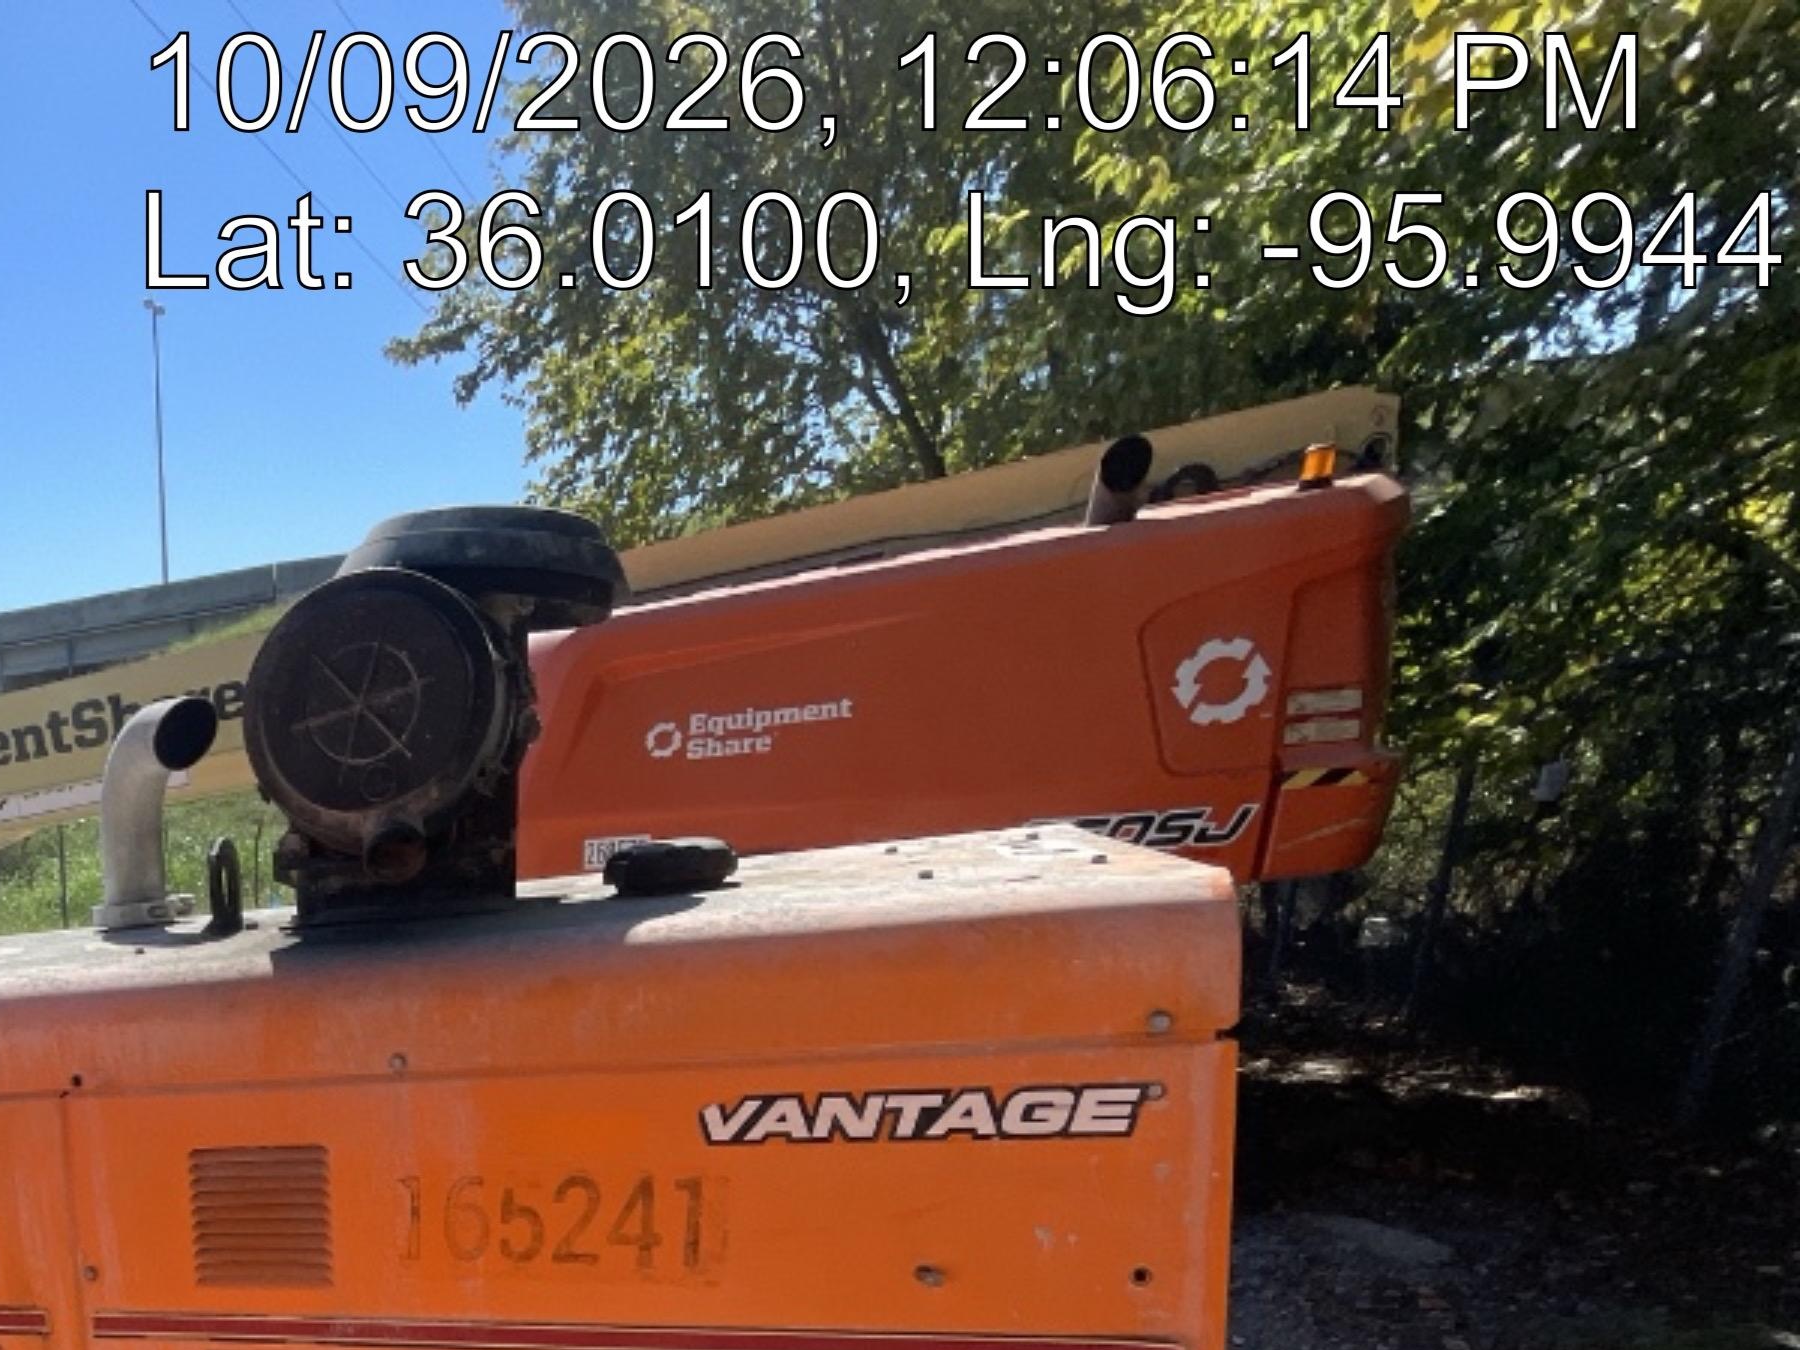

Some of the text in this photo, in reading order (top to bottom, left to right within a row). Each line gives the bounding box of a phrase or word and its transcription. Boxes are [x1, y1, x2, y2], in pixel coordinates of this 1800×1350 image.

[689, 698, 853, 736] Equipment
[686, 735, 773, 760] Share
[702, 1086, 1145, 1145] VANTAGE
